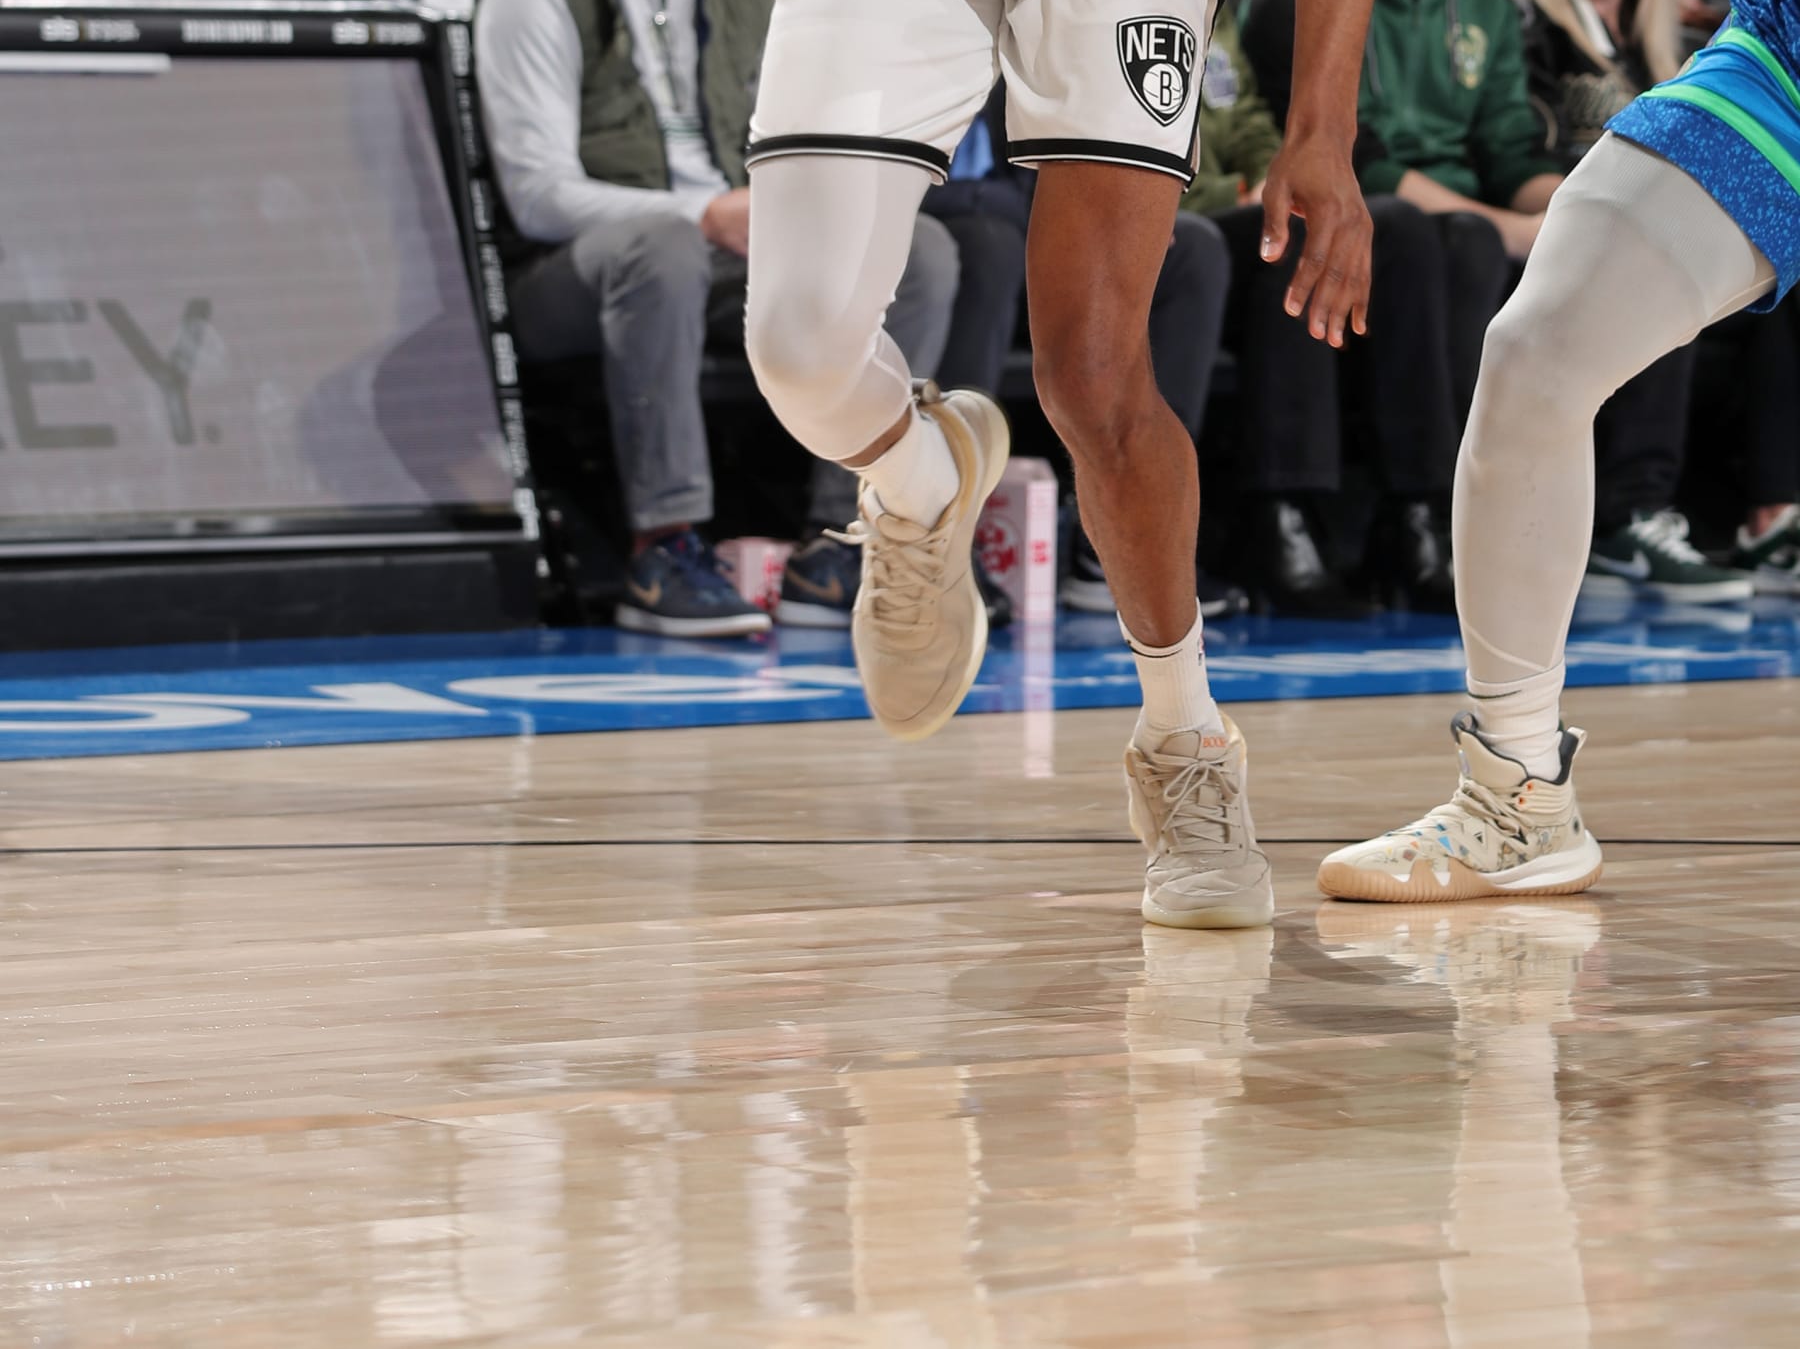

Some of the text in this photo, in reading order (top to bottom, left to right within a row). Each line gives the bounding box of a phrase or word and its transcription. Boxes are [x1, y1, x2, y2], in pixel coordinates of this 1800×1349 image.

[1126, 22, 1195, 73] NETS
[1160, 70, 1172, 107] B
[0, 297, 222, 450] EY.
